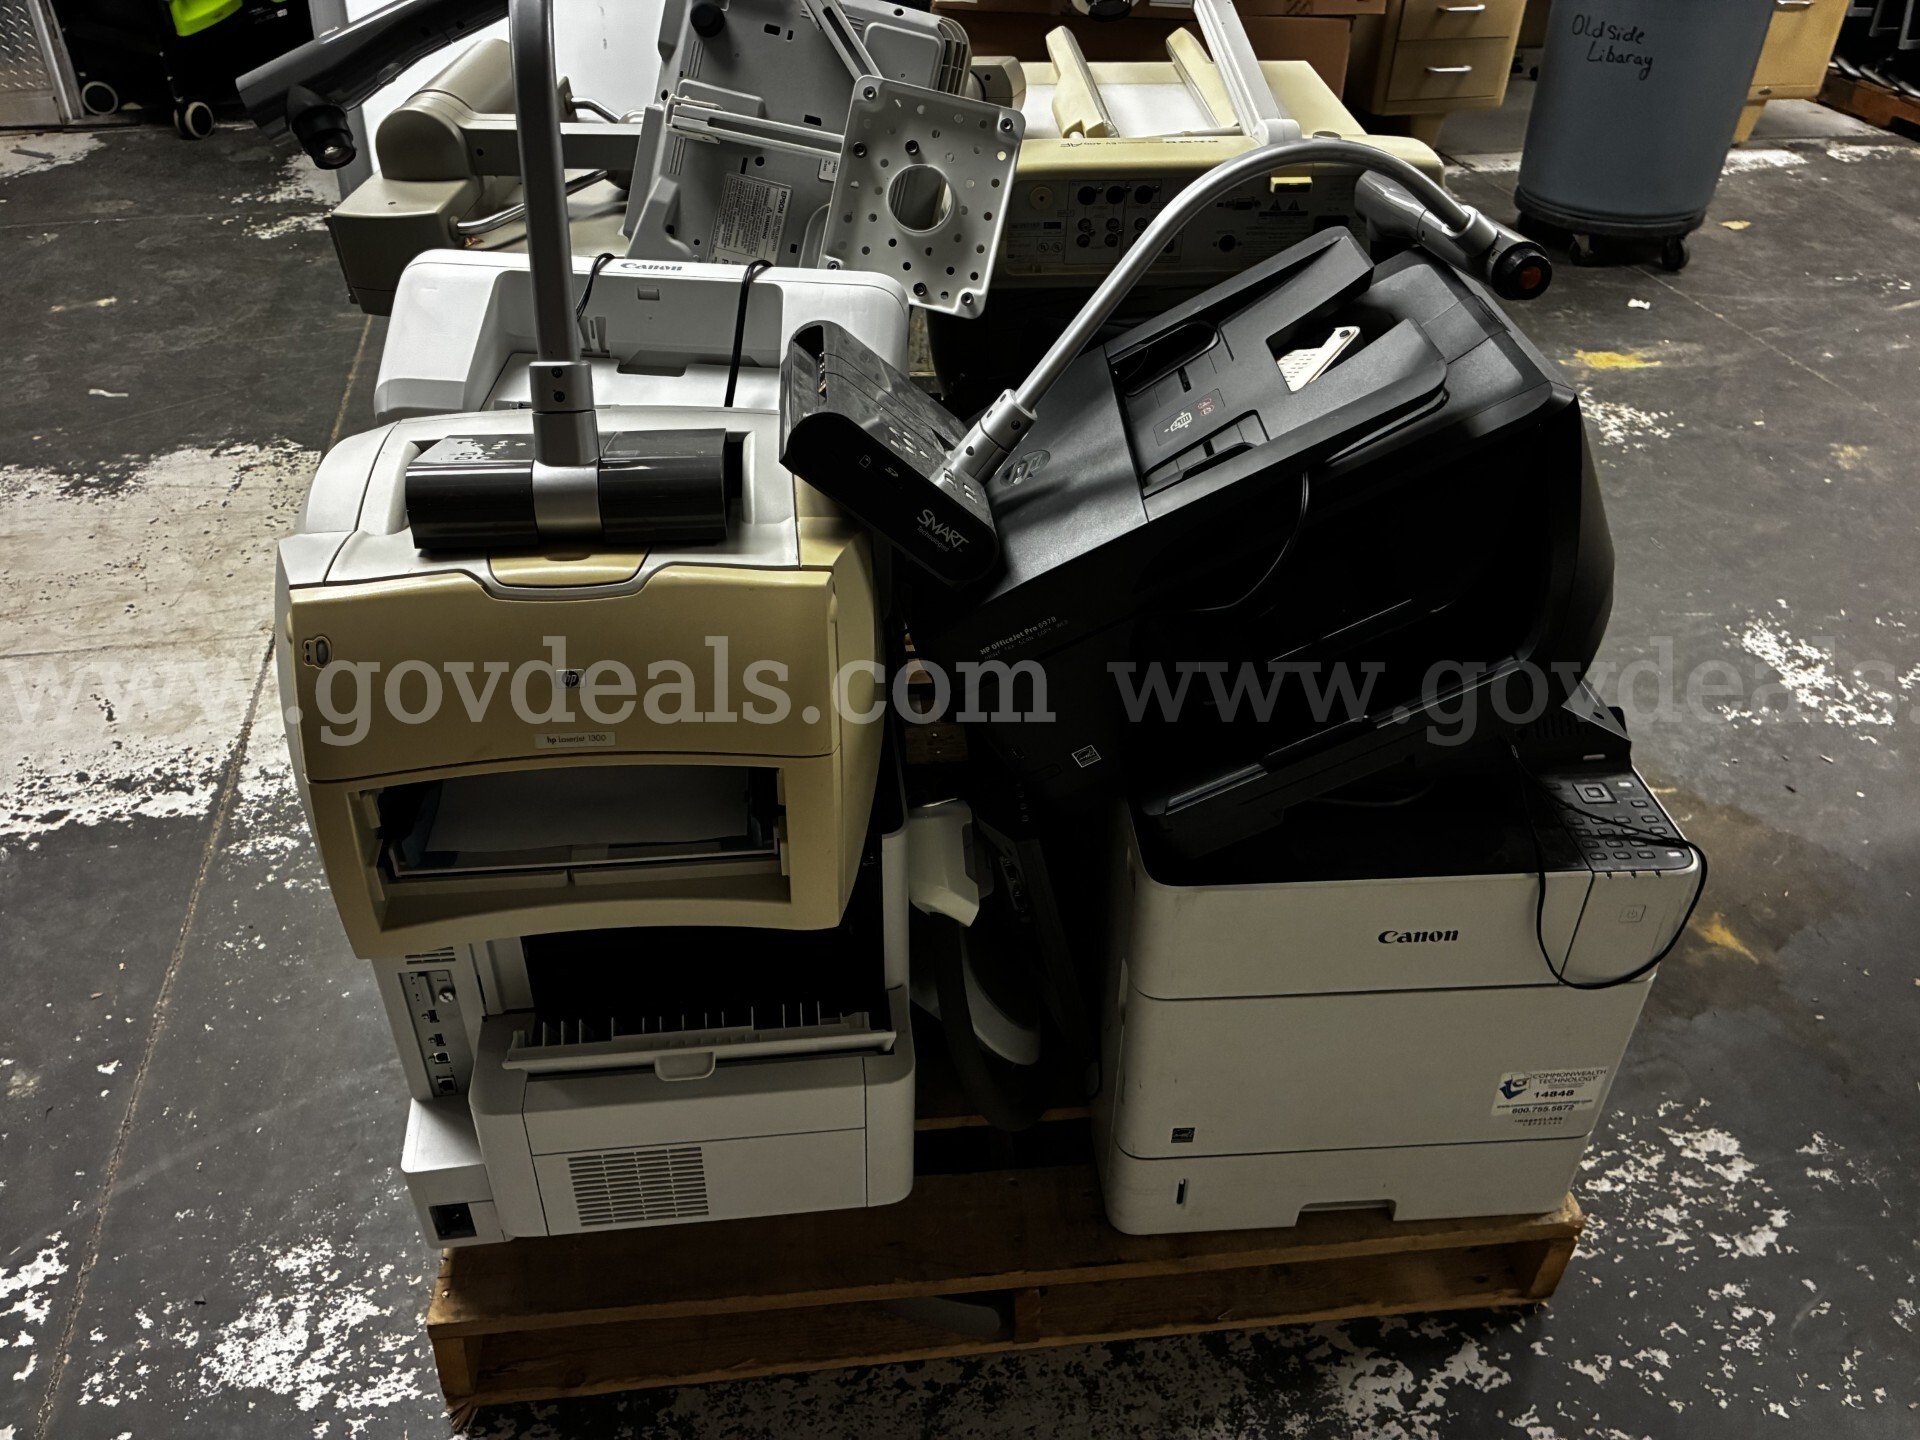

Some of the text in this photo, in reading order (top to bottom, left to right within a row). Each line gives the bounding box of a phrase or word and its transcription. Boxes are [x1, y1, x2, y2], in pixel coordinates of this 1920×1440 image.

[1587, 41, 1654, 81] Libaray
[777, 190, 788, 214] EPSON
[761, 214, 772, 240] WARNING
[619, 262, 683, 272] Canon
[916, 509, 969, 547] SMART
[1023, 626, 1039, 635] Pro
[546, 736, 557, 744] hp
[588, 734, 607, 742] 1300
[1378, 929, 1459, 944] Canon
[1532, 1069, 1607, 1079] COMMONWEALTH
[1539, 1075, 1598, 1084] TECHNOLOGY
